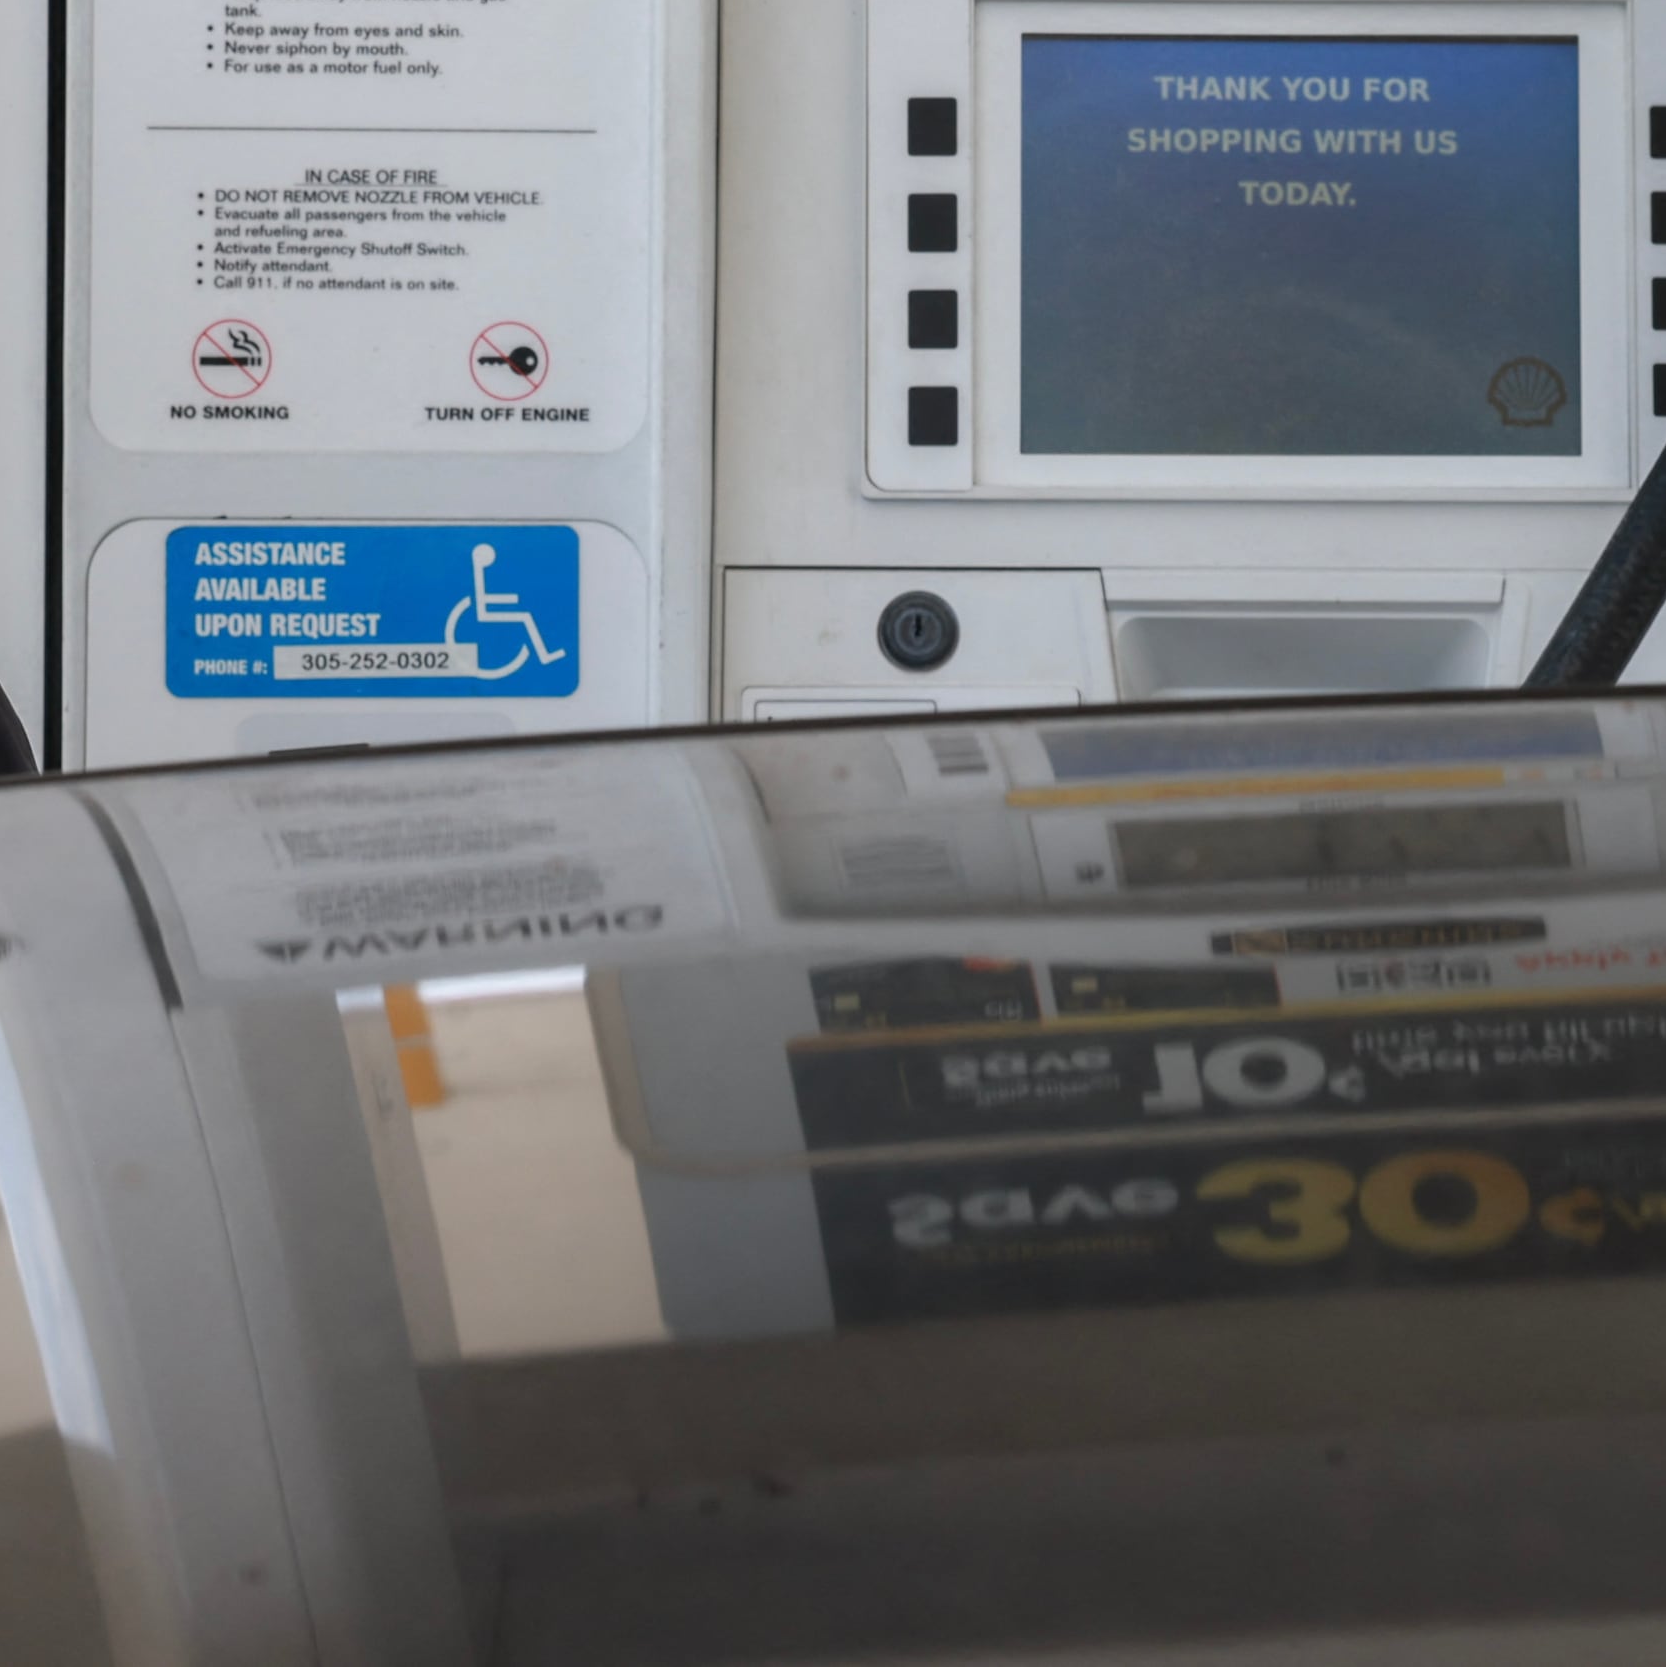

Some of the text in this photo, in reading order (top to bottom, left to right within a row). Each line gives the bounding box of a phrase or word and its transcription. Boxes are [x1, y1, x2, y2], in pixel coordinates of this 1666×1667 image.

[1154, 76, 1431, 103] THANK YOU FOR
[1127, 128, 1458, 156] SHOPPING WITH US
[304, 169, 438, 185] IN CASE OF FIRE
[1237, 180, 1355, 205] TODAY.
[170, 406, 290, 421] NO SMOKING
[425, 406, 591, 422] TURN OFF ENGINE
[194, 541, 346, 567] ASSISTANCE
[194, 577, 327, 602] AVAILABLE
[194, 613, 381, 638] UPON REQUEST
[194, 659, 248, 676] PHONE
[301, 650, 449, 671] 305-252-0302
